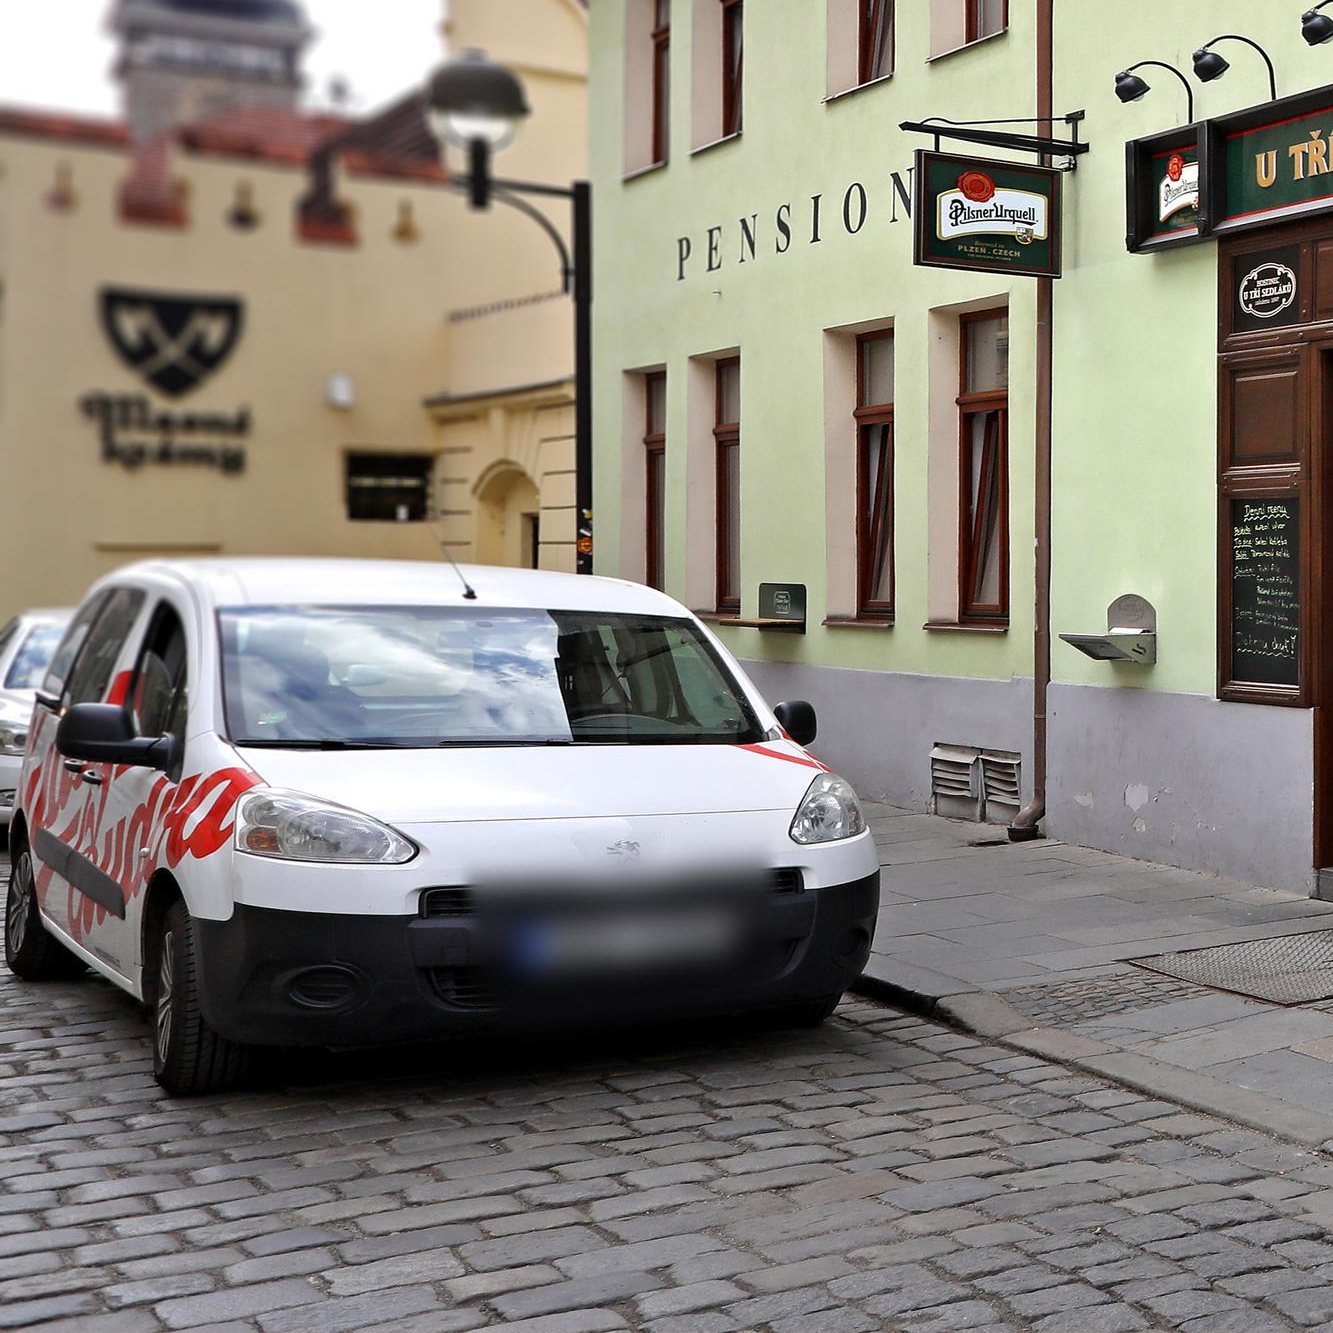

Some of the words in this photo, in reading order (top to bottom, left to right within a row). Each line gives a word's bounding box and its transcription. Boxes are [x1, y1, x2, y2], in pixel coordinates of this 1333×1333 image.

[1255, 150, 1277, 188] U
[677, 166, 914, 281] PENSION
[949, 199, 995, 227] Pilsner
[993, 202, 1036, 223] Urquell
